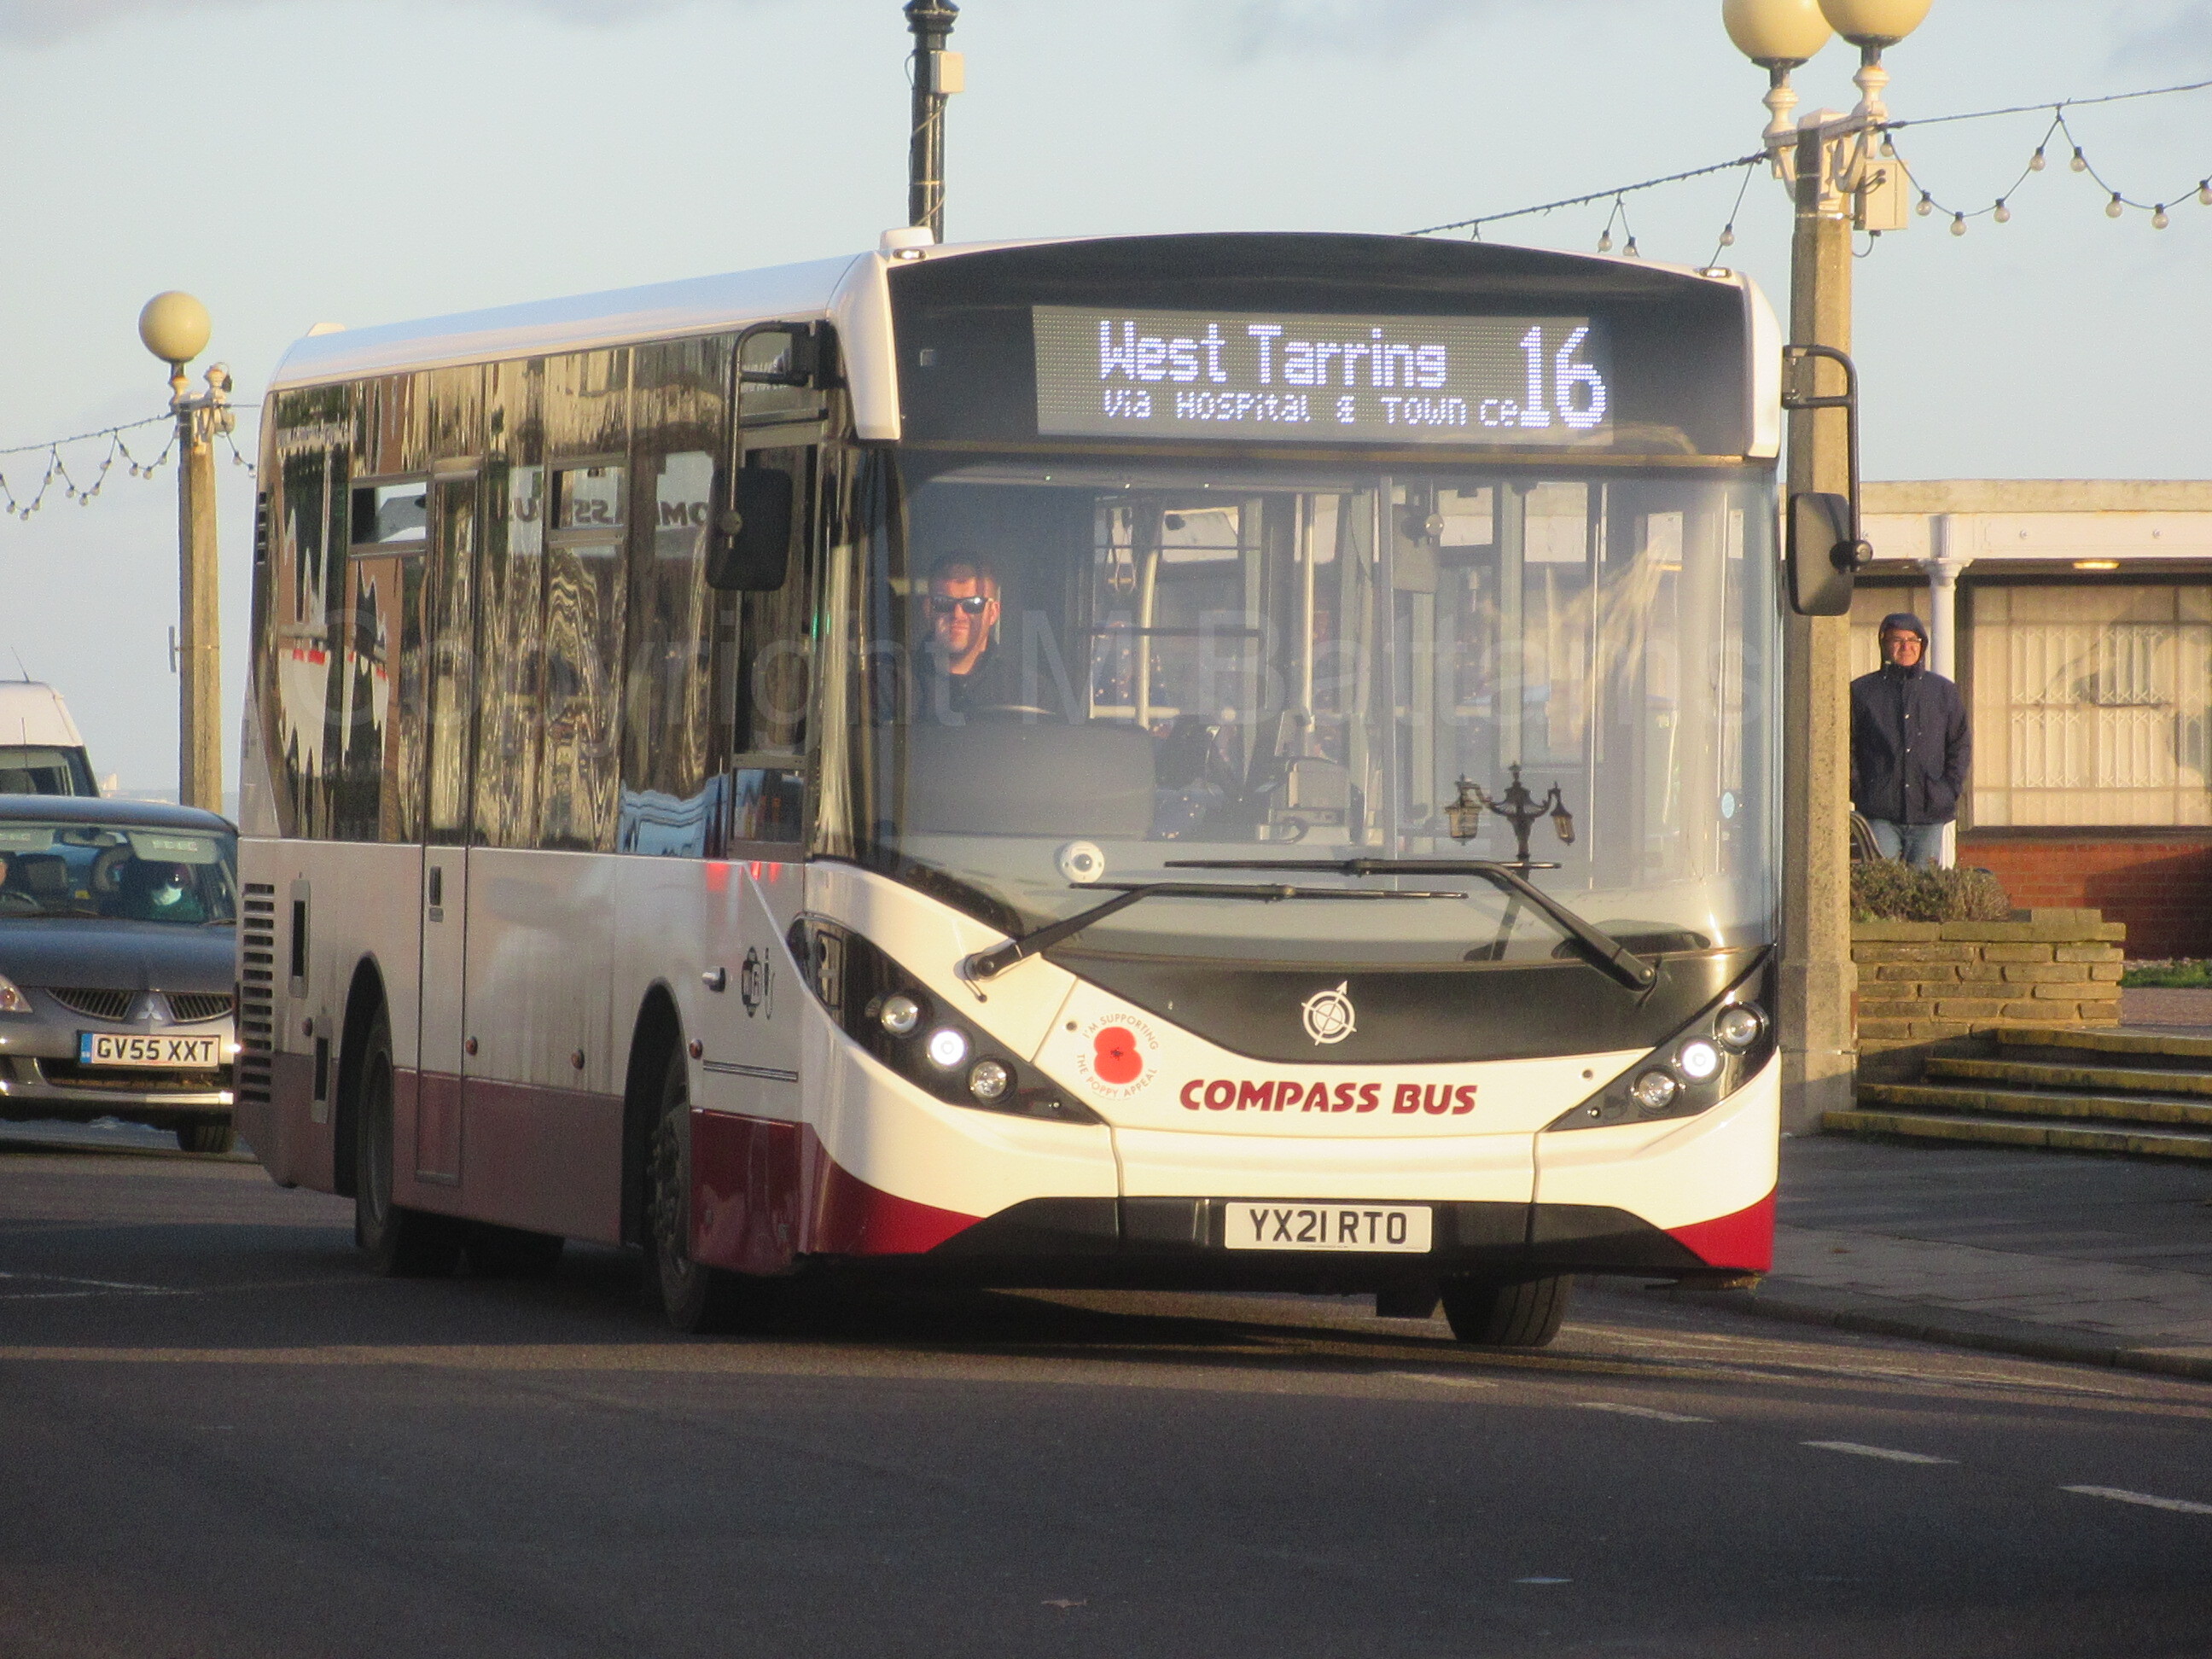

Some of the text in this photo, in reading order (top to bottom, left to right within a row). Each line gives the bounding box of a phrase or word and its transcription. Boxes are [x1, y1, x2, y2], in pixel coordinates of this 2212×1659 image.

[1100, 319, 1447, 389] West Tarring
[1520, 325, 1606, 428] 16
[96, 1037, 214, 1062] GV55 XXT
[1082, 1013, 1159, 1050] I'M SUPPORTING
[1077, 1054, 1089, 1074] THE
[1086, 1075, 1119, 1097] POPPY
[1124, 1068, 1158, 1097] APPEAL
[1179, 1079, 1479, 1115] COMPASS BUS
[1249, 1208, 1407, 1245] YX21 RTO
